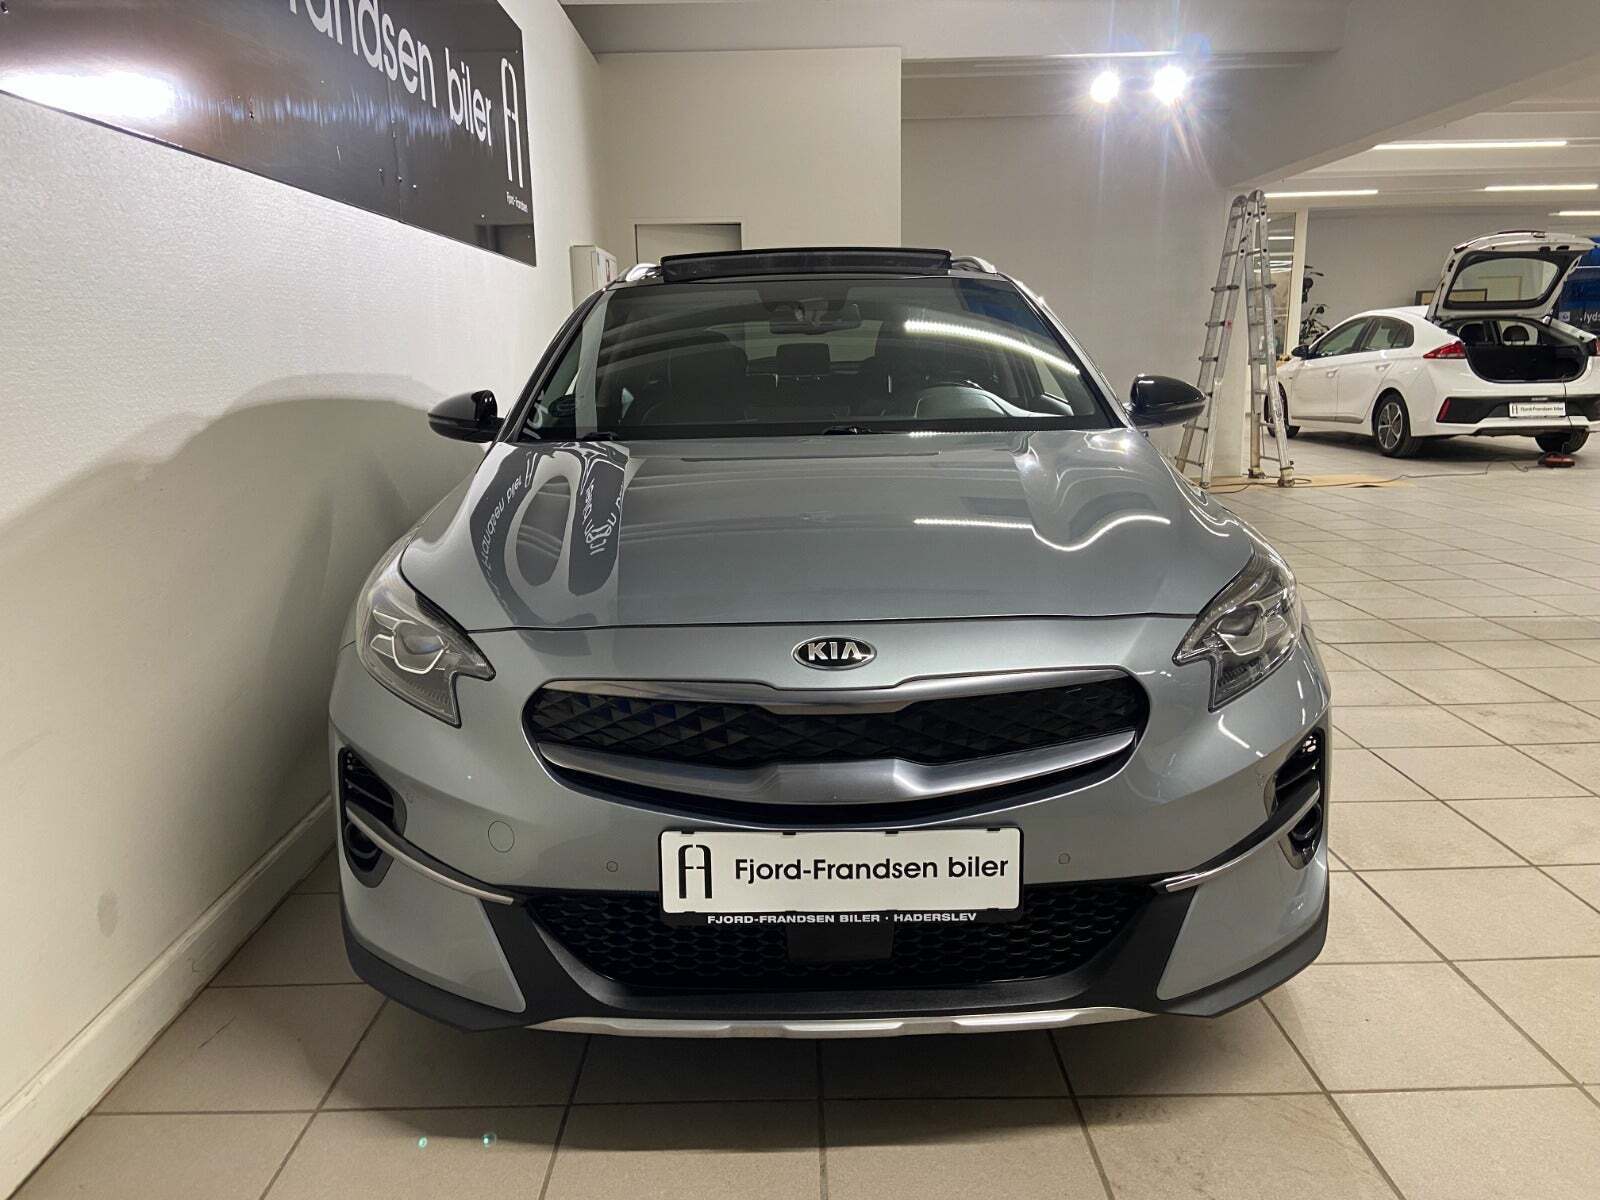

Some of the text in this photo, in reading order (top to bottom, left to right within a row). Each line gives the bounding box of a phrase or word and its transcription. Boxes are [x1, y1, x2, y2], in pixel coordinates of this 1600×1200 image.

[445, 48, 492, 147] biler
[807, 641, 863, 661] KIA
[734, 856, 1009, 884] Fjord-Frandsen biler
[707, 912, 978, 924] FJORD-FRANDSEN BILER HADERSLEV
